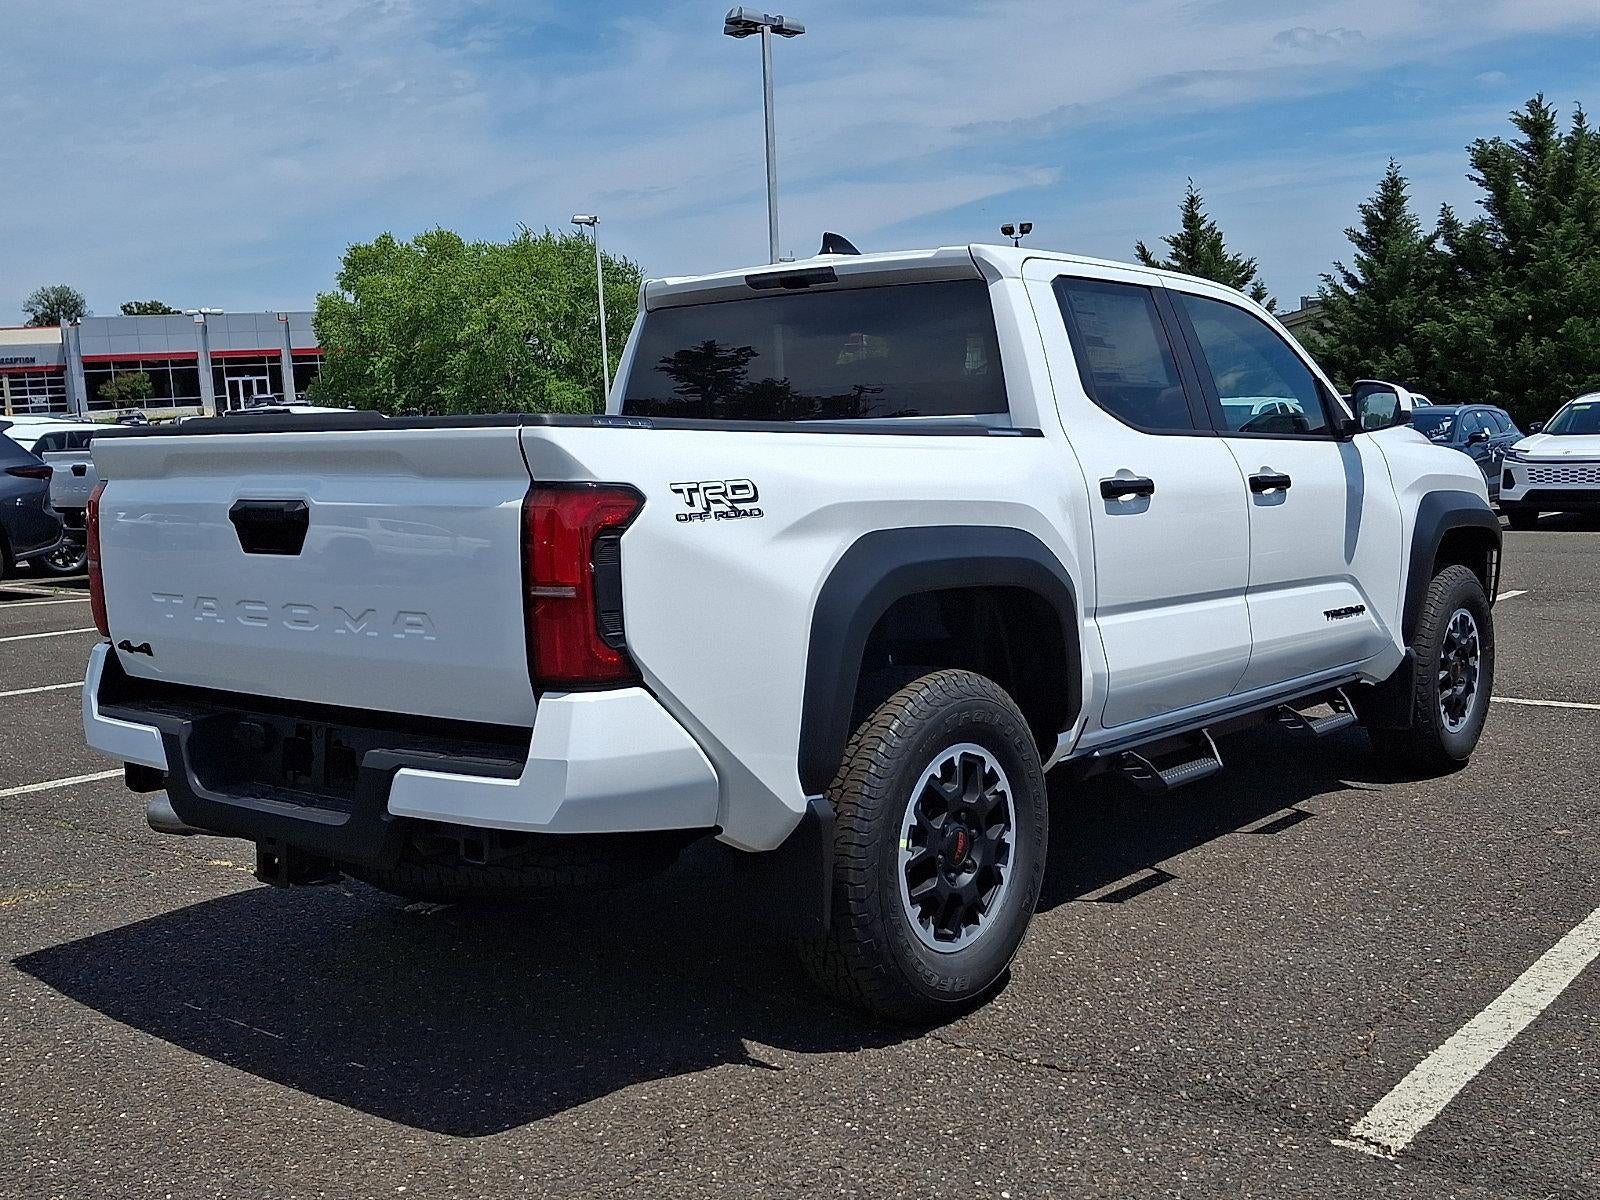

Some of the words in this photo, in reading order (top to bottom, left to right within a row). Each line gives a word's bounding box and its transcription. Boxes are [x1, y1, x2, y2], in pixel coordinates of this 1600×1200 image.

[670, 478, 759, 511] TRD
[676, 512, 711, 523] OFF
[714, 508, 764, 521] ROAD
[152, 592, 436, 640] TACOMA
